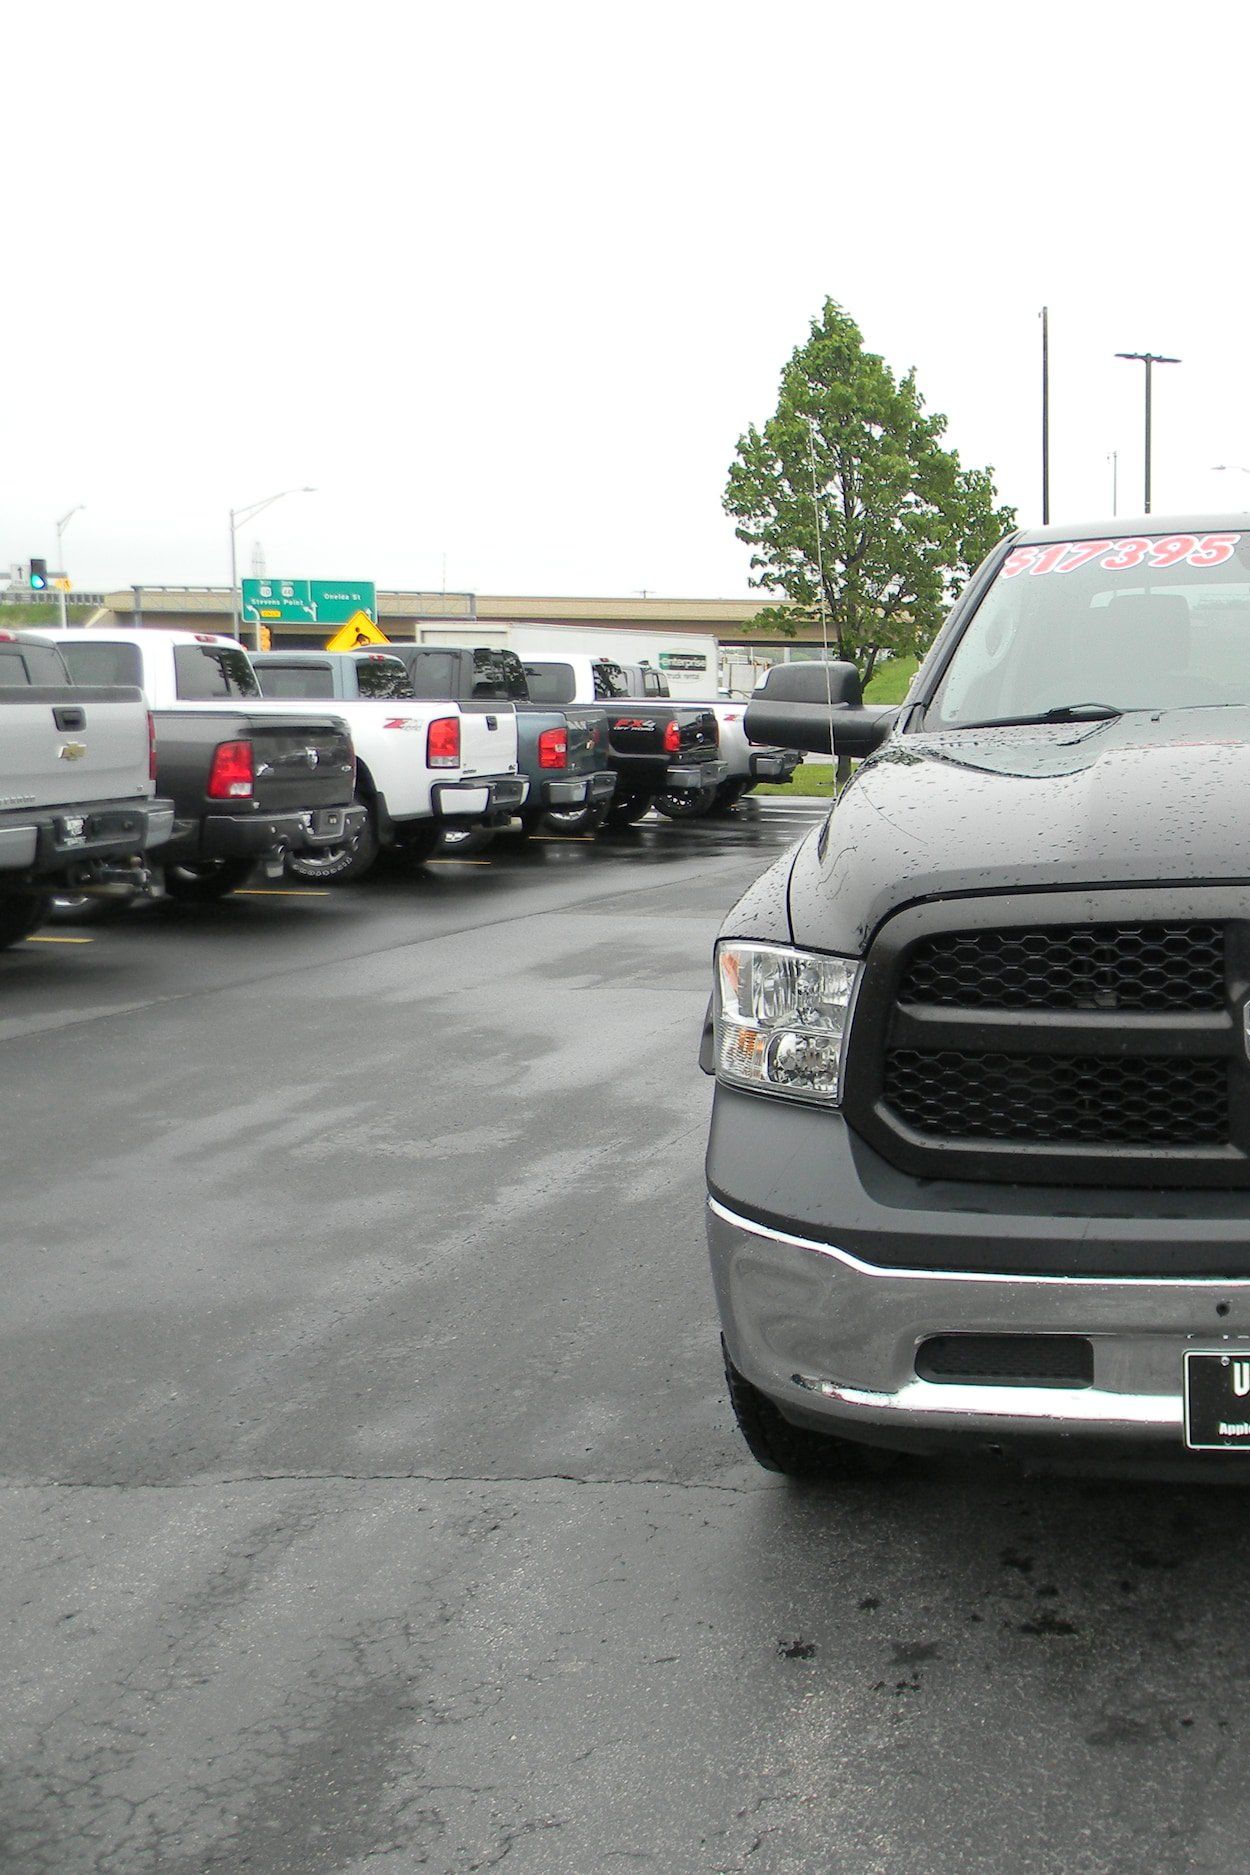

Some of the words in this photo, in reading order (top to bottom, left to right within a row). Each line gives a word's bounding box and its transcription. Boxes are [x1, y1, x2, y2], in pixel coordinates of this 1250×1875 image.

[1002, 534, 1242, 579] $17395
[352, 592, 362, 600] St
[251, 598, 280, 606] Stevens
[283, 598, 304, 606] Point
[660, 656, 706, 669] enterprise
[614, 719, 656, 728] FX4
